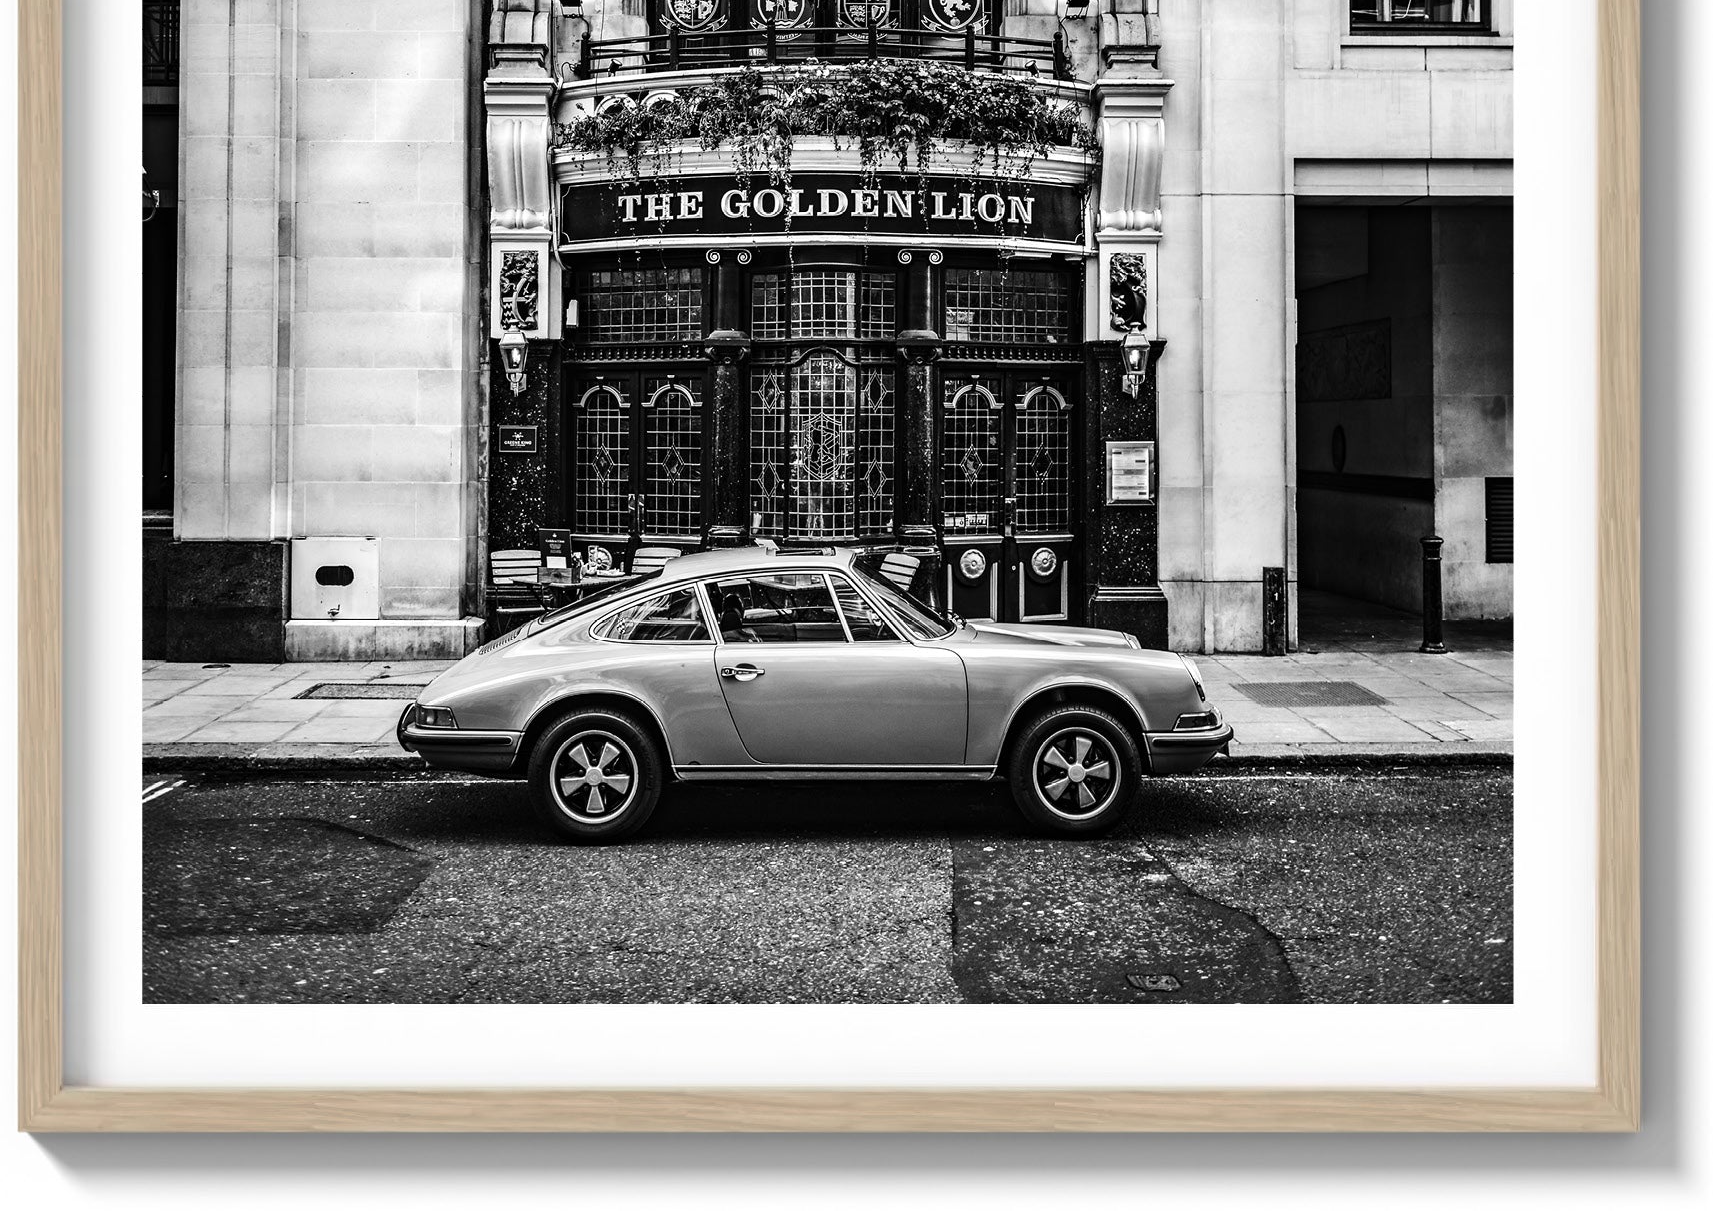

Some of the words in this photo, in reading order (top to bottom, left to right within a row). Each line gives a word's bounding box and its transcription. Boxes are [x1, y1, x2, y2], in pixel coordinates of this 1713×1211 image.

[617, 191, 703, 223] THE
[720, 189, 916, 219] GOLDEN
[931, 191, 1034, 224] LION
